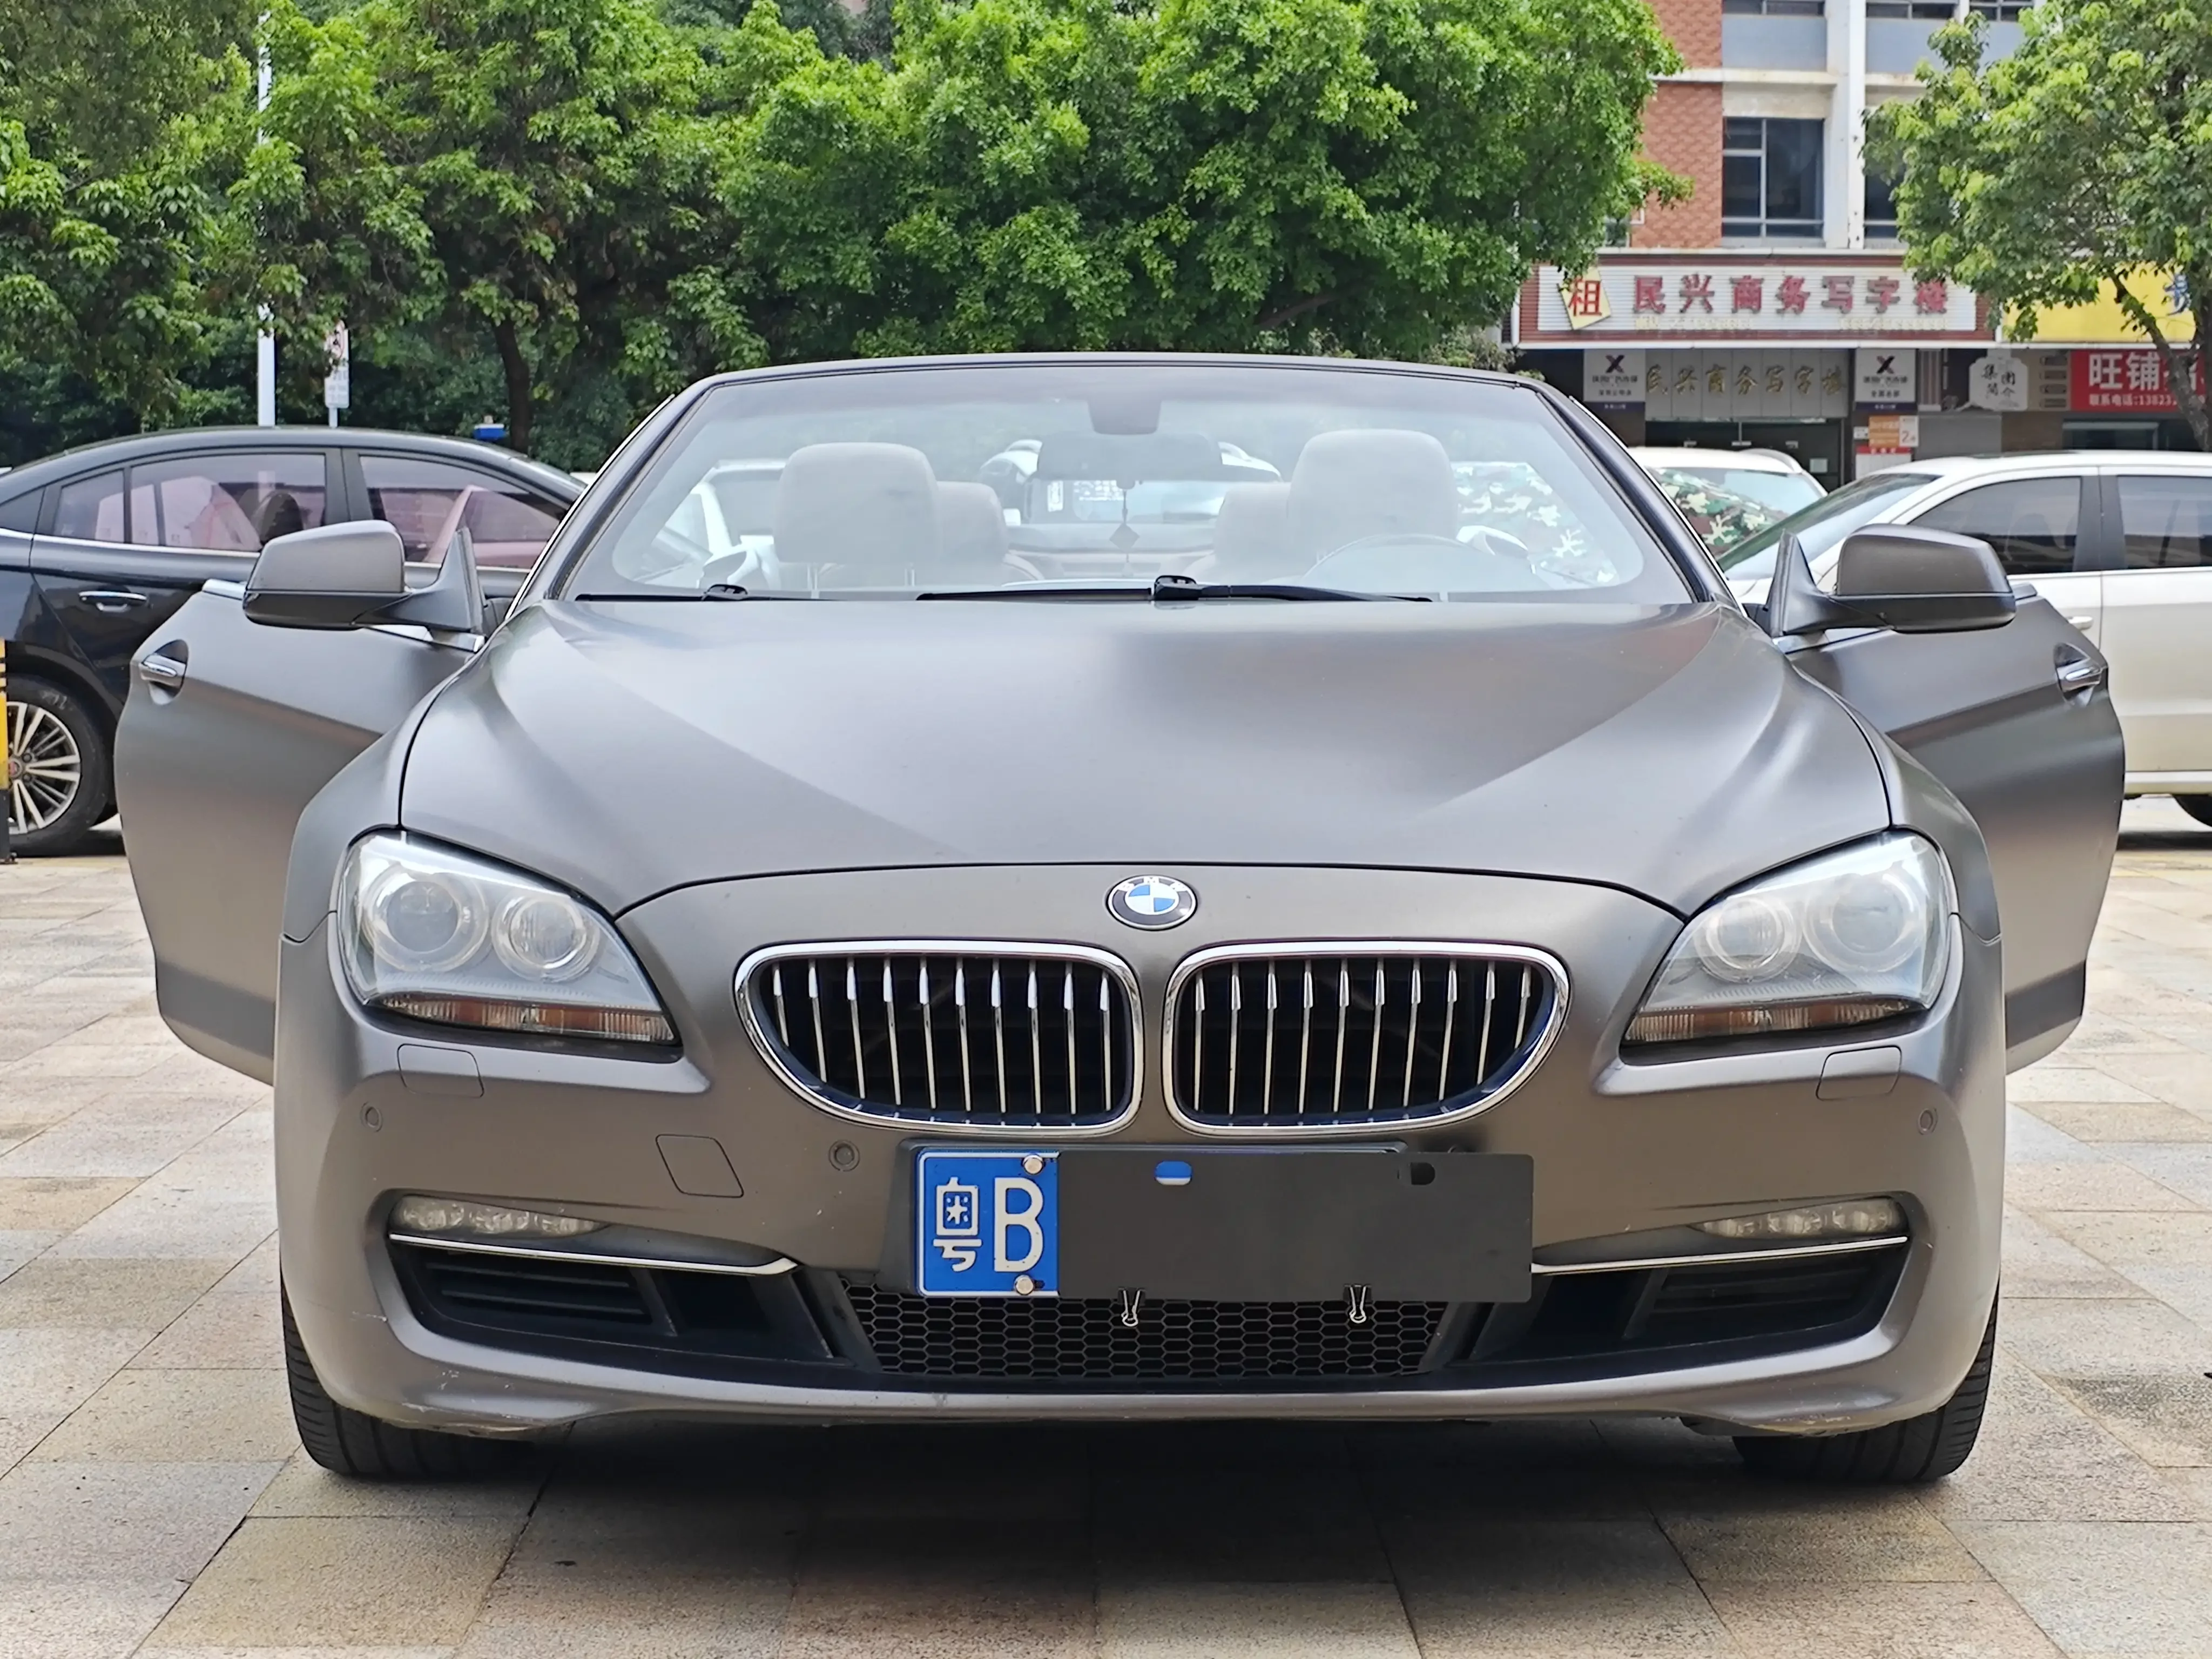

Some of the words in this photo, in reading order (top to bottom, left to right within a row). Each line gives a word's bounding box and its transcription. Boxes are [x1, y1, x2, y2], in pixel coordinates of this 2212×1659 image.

[1568, 274, 1602, 317] 租
[1633, 273, 1948, 315] 民兴商务写字楼
[2088, 352, 2196, 391] 旺铺
[1117, 876, 1189, 892] BMW
[933, 1176, 1044, 1272] 粤B
